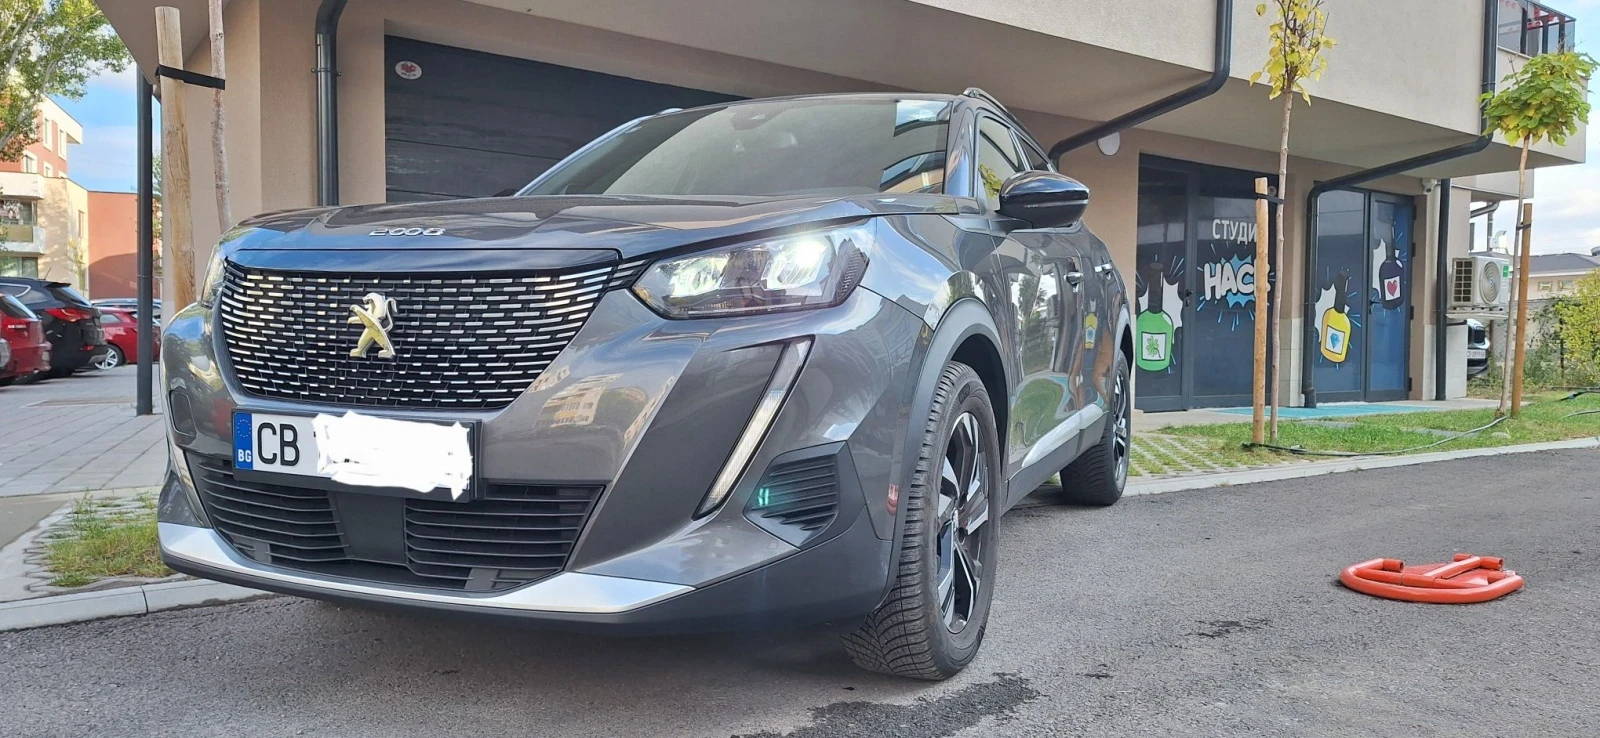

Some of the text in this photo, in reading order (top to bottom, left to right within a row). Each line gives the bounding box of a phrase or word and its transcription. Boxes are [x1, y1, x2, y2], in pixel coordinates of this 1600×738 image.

[368, 227, 446, 236] 2008
[1212, 218, 1257, 245] СТУДИ
[237, 422, 300, 467] BG CB
